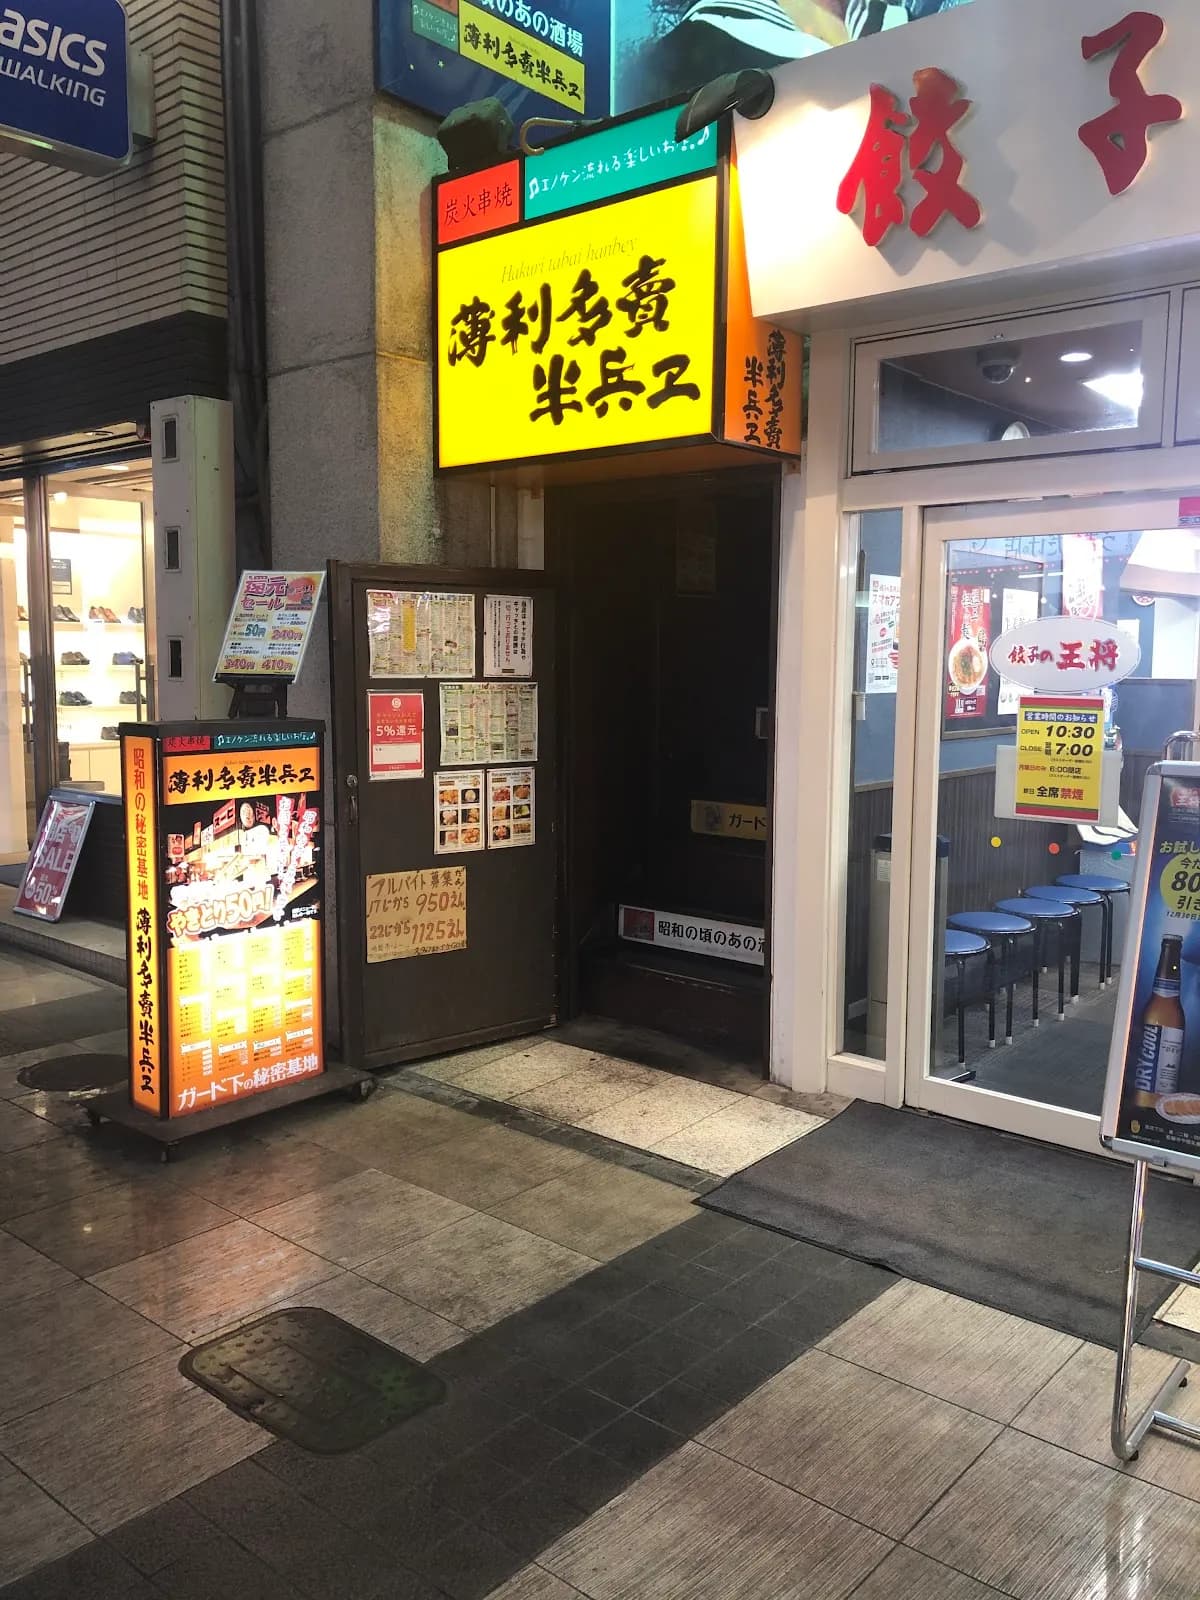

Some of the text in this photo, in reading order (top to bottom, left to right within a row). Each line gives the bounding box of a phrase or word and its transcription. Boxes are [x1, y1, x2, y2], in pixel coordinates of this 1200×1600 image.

[443, 181, 514, 226] 炭火串焼
[240, 597, 286, 611] セール
[1007, 638, 1120, 673] 餃子の王将
[1025, 712, 1097, 723] 営業時間のお知らせ
[1046, 725, 1095, 739] 10:30
[1055, 743, 1094, 757] 7:00
[133, 748, 149, 901] 昭和の秘密基地
[36, 845, 75, 874] SALE
[1166, 911, 1200, 921] 12月30日
[177, 1053, 319, 1111] ガード下の秘密基地
[1134, 1059, 1153, 1091] DRY
